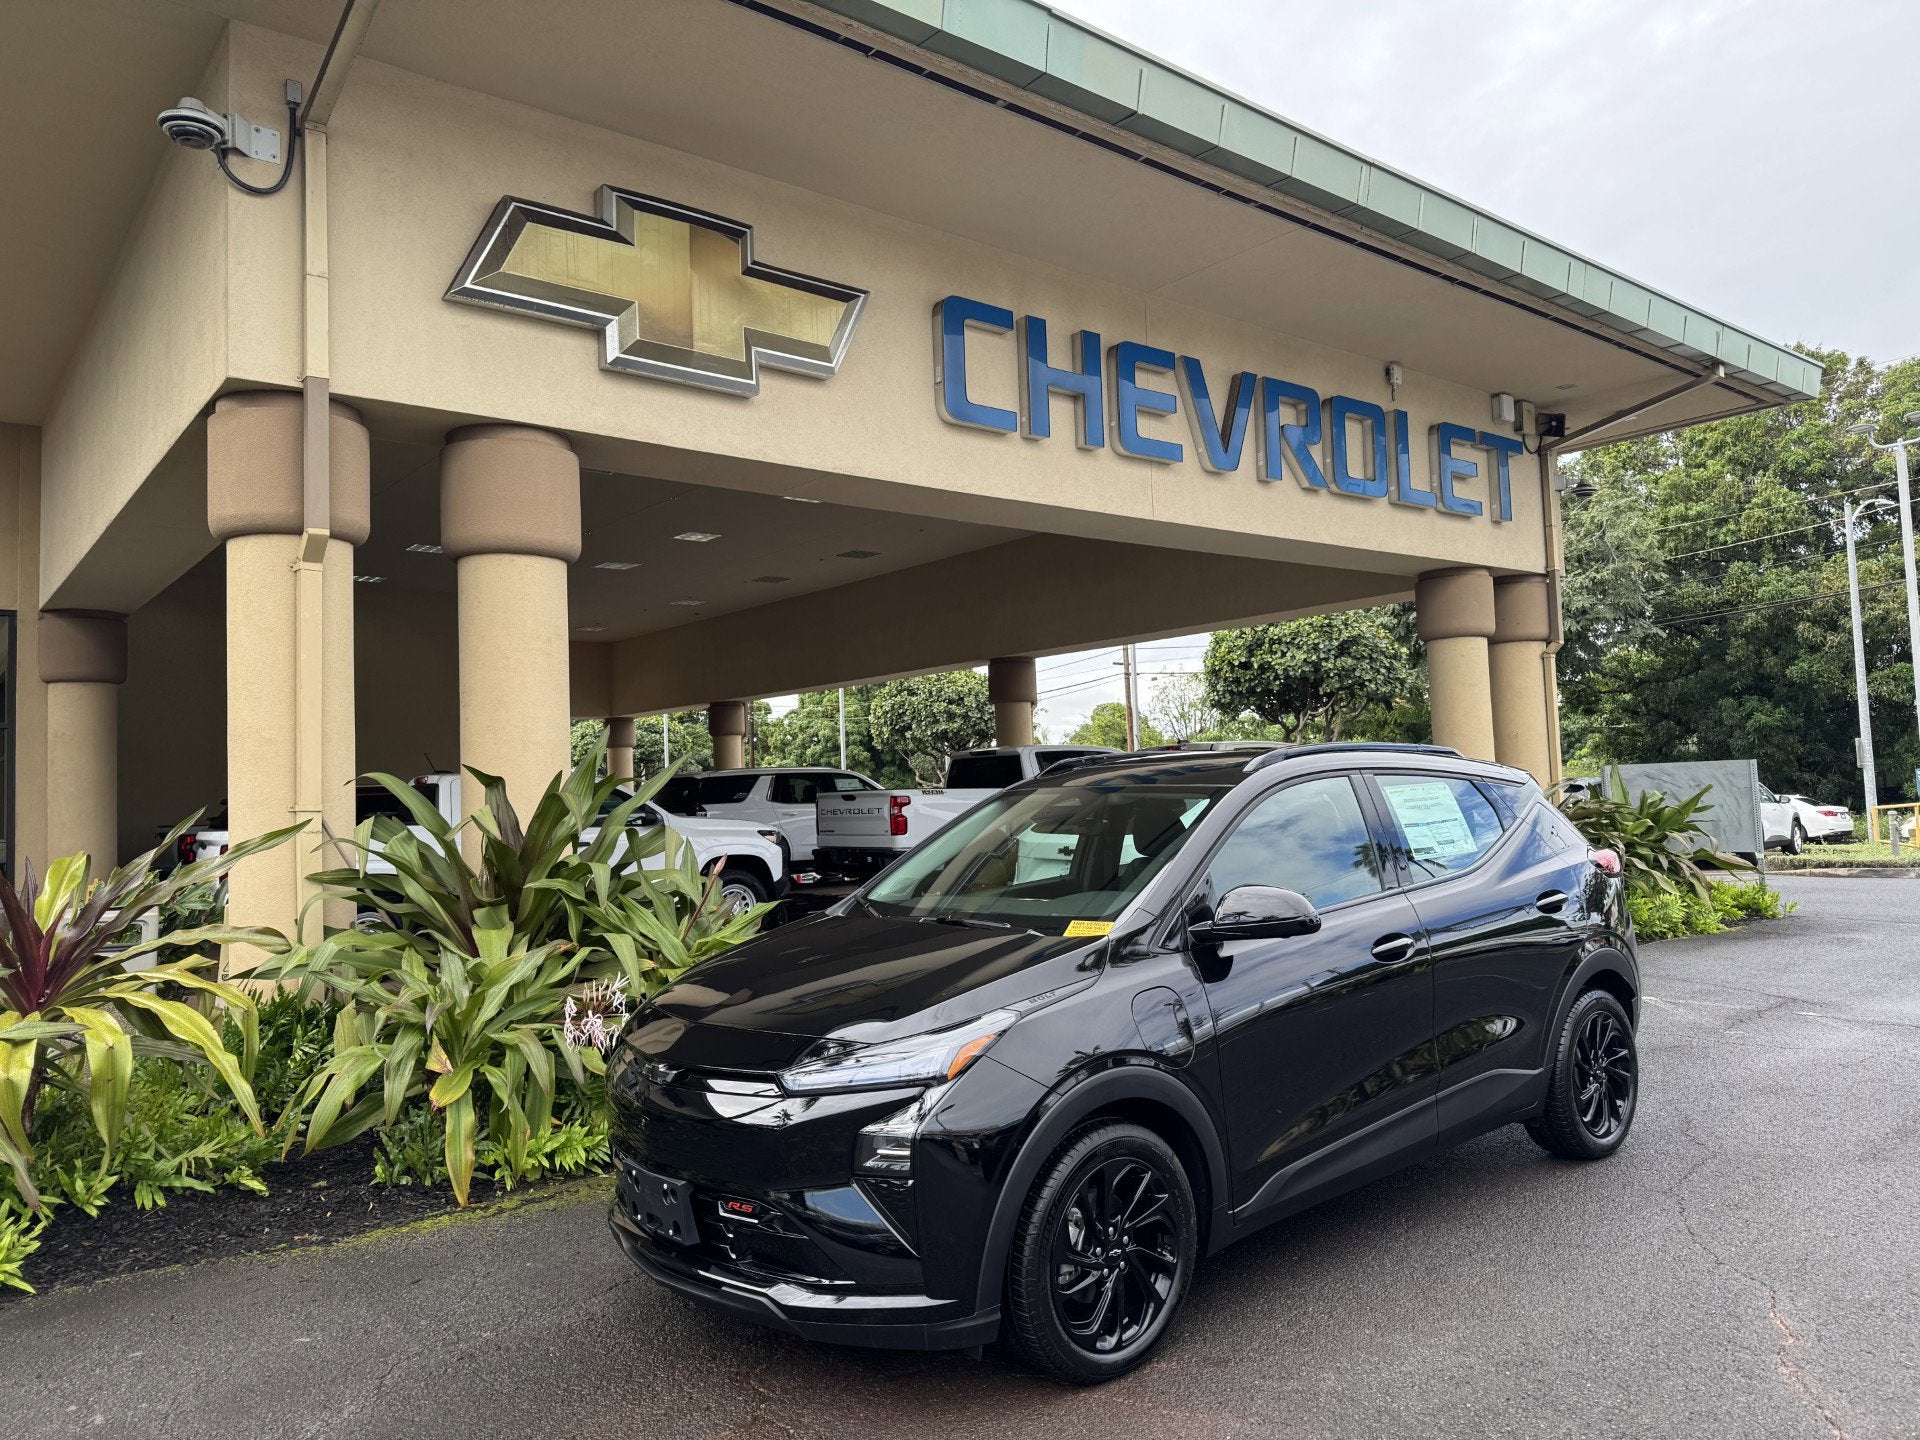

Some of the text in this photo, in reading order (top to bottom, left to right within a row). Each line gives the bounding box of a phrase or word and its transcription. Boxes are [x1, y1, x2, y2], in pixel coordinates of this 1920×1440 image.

[933, 295, 1523, 523] CHEVROLET
[820, 807, 883, 816] CHEVROLET
[1029, 991, 1056, 1003] BOLT
[728, 1201, 753, 1212] RS
